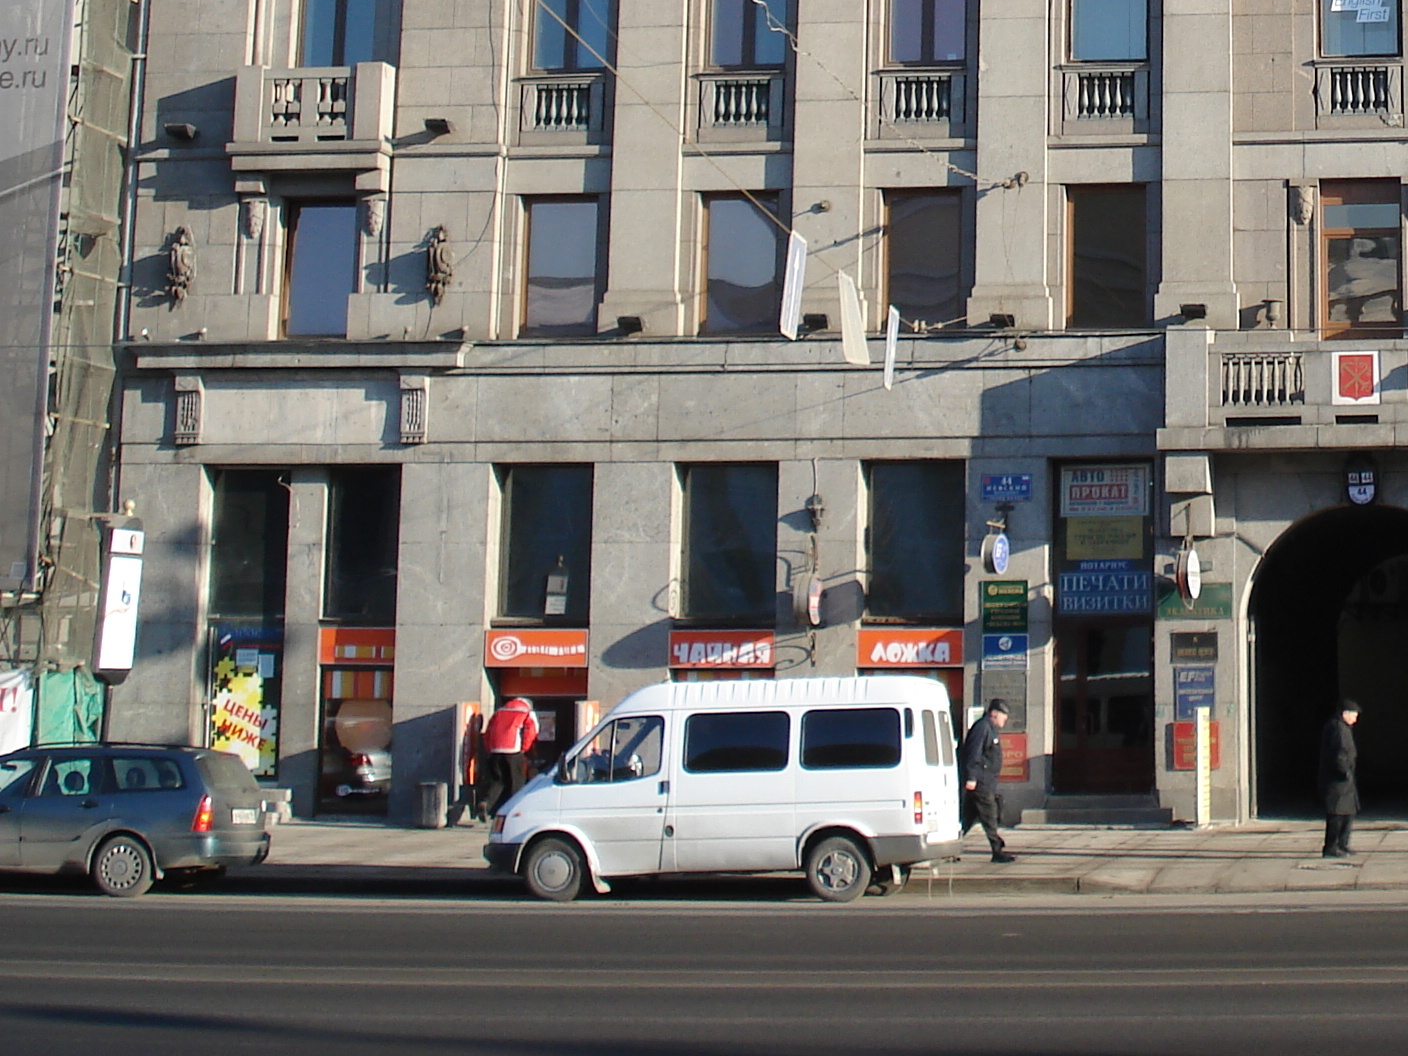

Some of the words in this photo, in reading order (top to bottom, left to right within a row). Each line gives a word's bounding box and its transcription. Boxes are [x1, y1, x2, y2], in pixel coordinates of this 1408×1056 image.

[1359, 8, 1387, 21] First
[0, 37, 49, 63] y.ru
[1071, 470, 1105, 483] АВТО
[1071, 485, 1128, 499] ПРОКАТ
[1063, 575, 1149, 592] ПЕЧАТИ
[1063, 594, 1148, 611] ВИЗИТКИ
[673, 642, 771, 664] ЧАЙНАЯ
[870, 641, 951, 663] ЛОЖКА
[223, 699, 268, 730] ЦЕНЫ
[220, 719, 267, 750] НИЖЕ
